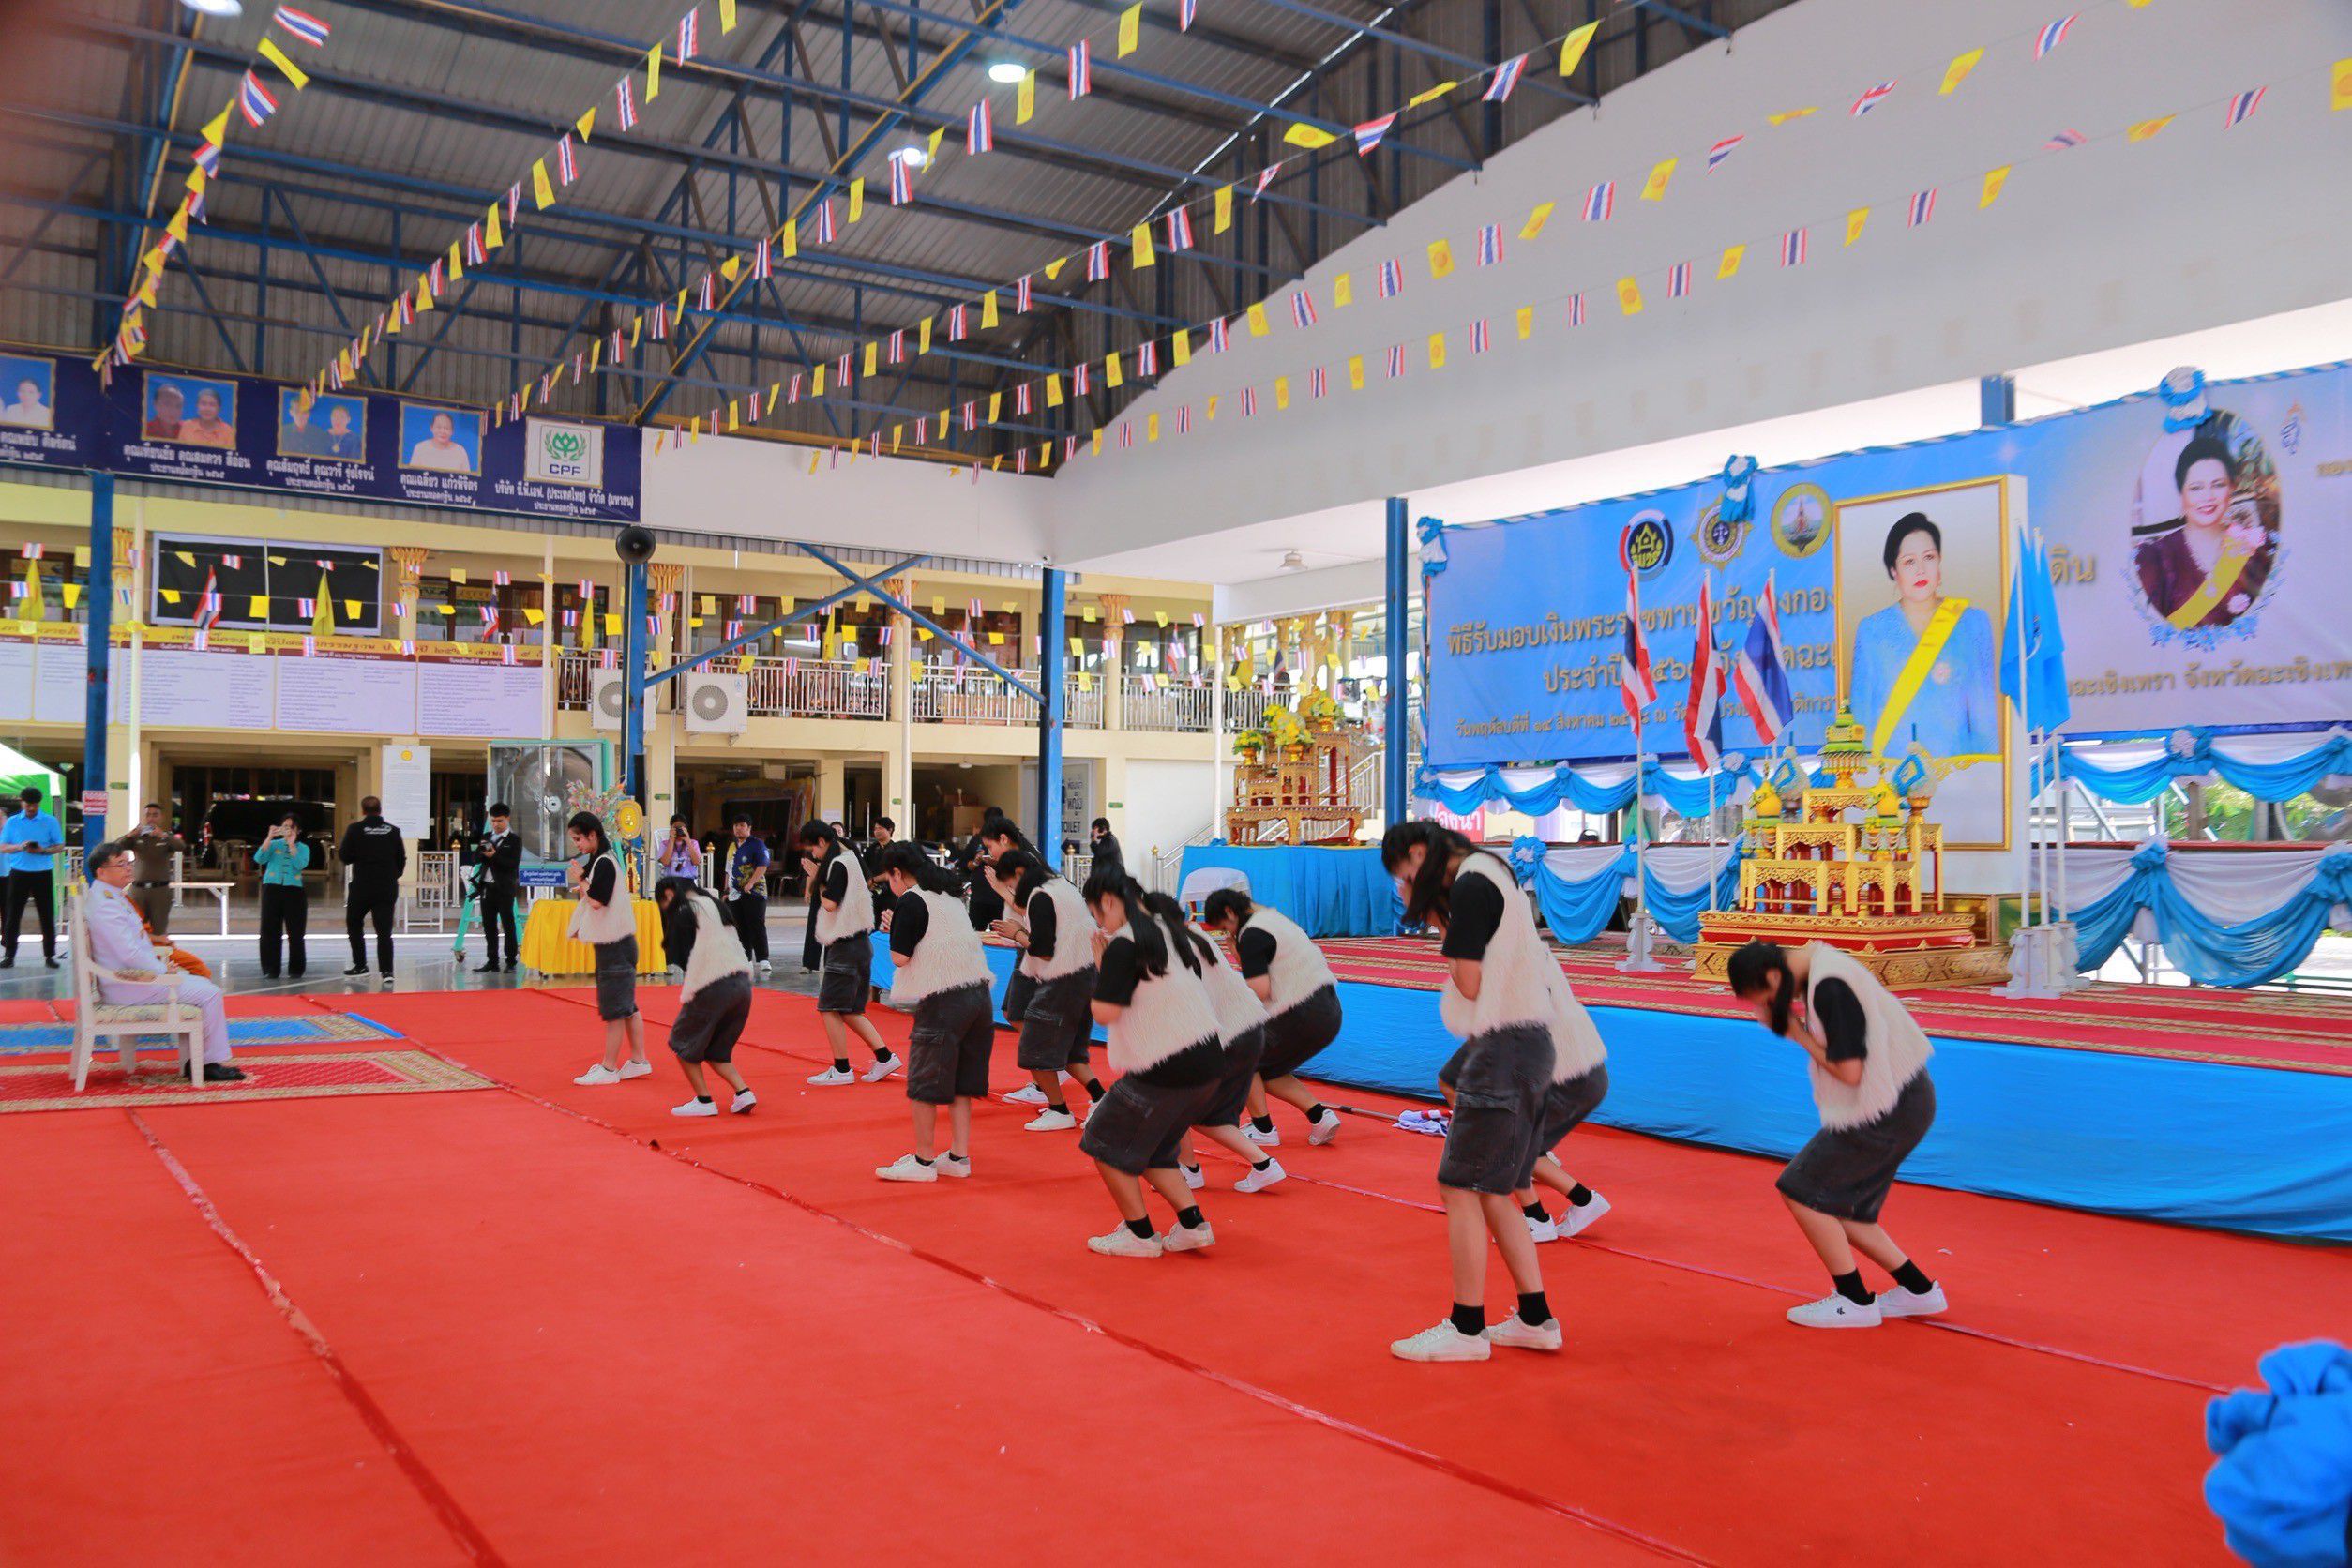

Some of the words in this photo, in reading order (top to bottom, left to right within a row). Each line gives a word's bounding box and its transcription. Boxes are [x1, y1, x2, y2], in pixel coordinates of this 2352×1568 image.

[550, 463, 581, 475] CPF
[1544, 652, 1624, 693] ประจำปี
[1556, 712, 1606, 731] สิงหาคม
